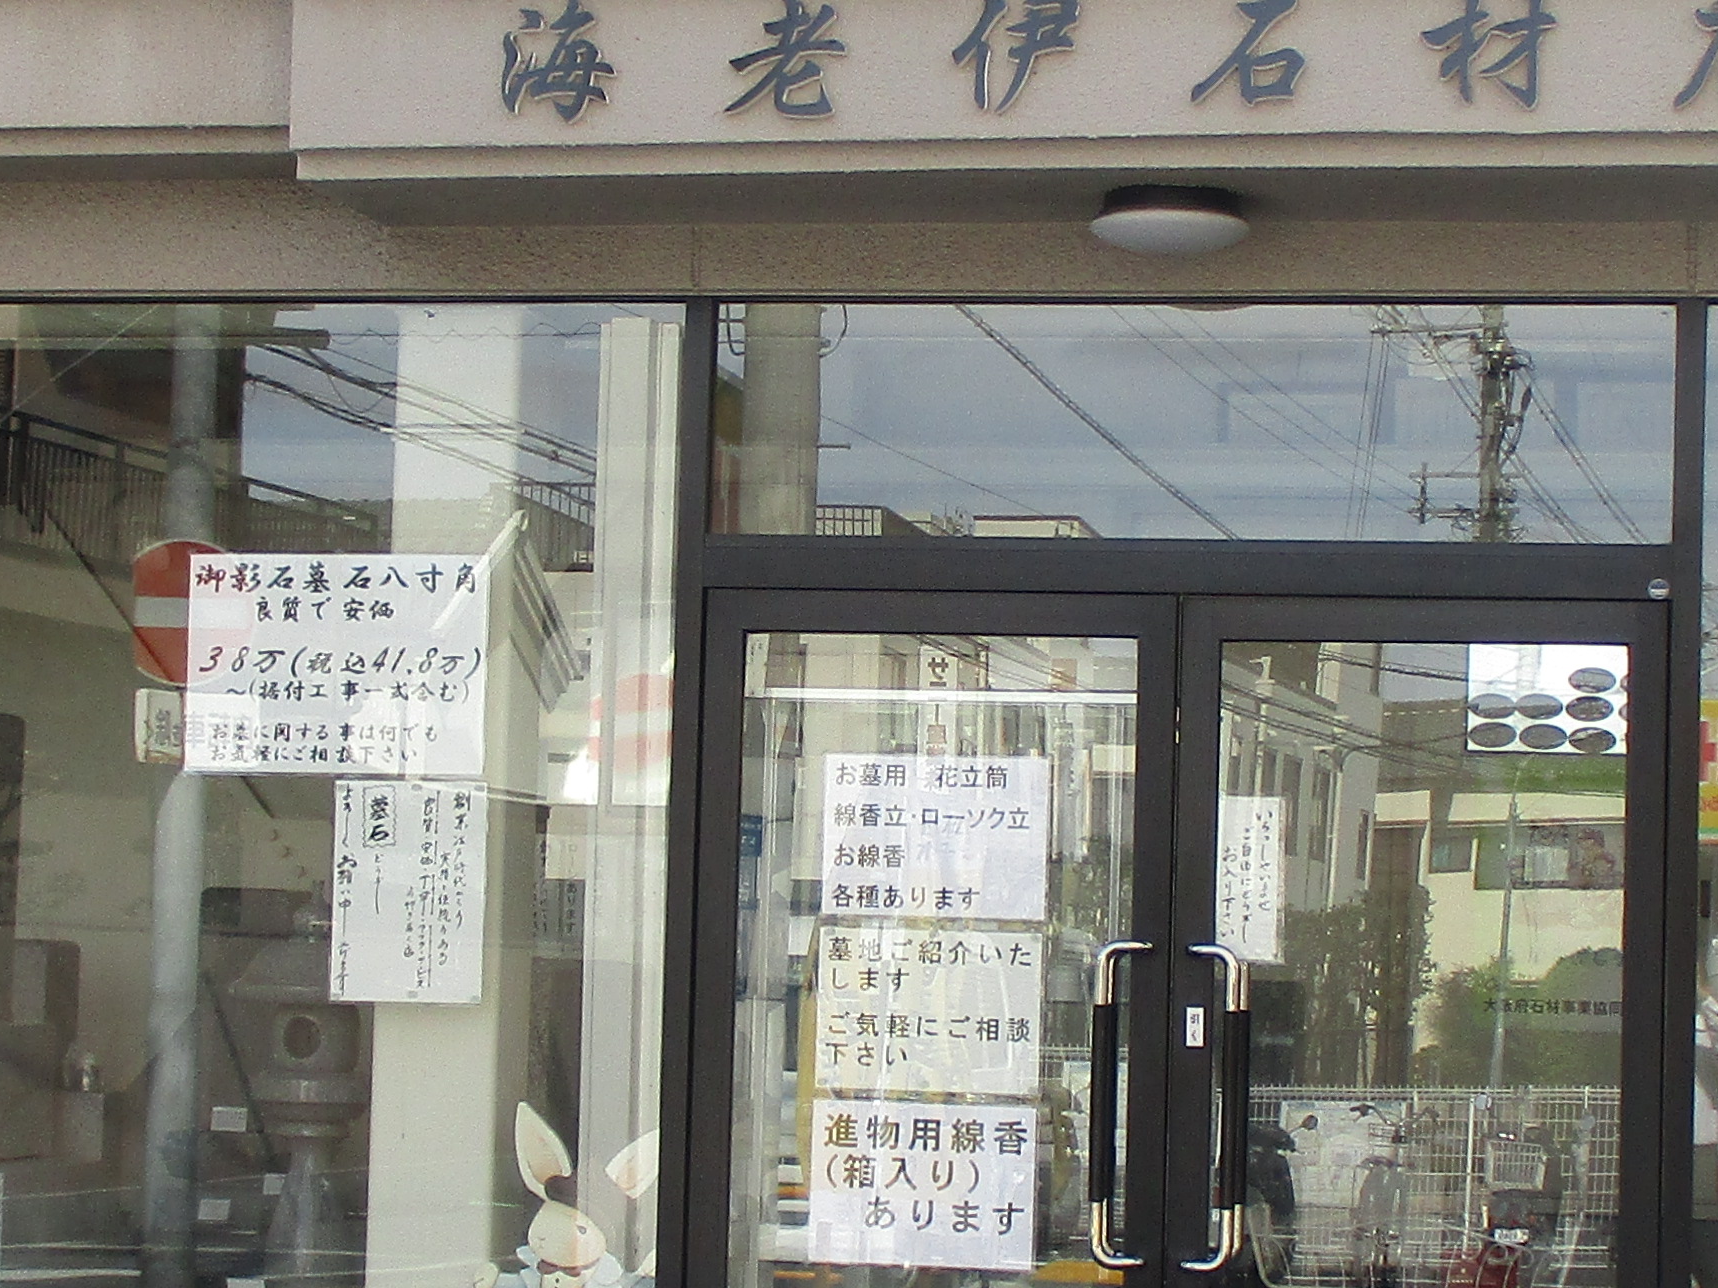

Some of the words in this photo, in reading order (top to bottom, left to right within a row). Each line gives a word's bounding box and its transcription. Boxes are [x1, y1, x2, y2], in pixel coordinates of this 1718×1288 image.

[255, 596, 395, 621] 良質で安価
[212, 723, 438, 742] お墓に関する事は何でも
[212, 743, 418, 764] お気軽にご相談下さい
[835, 762, 907, 788] お墓用
[935, 762, 1009, 790] 花立筒
[368, 797, 390, 841] 墓石
[833, 843, 906, 869] お線香
[831, 884, 982, 911] 各種あります
[828, 936, 1032, 967] 墓地ご紹介いた
[828, 967, 911, 993] します
[828, 1011, 1031, 1042] ご気軽にご相談
[825, 1042, 908, 1067] 下さい
[823, 1114, 1030, 1156] 進物用線香
[825, 1153, 982, 1193] (箱入り)
[865, 1199, 1027, 1237] あります
